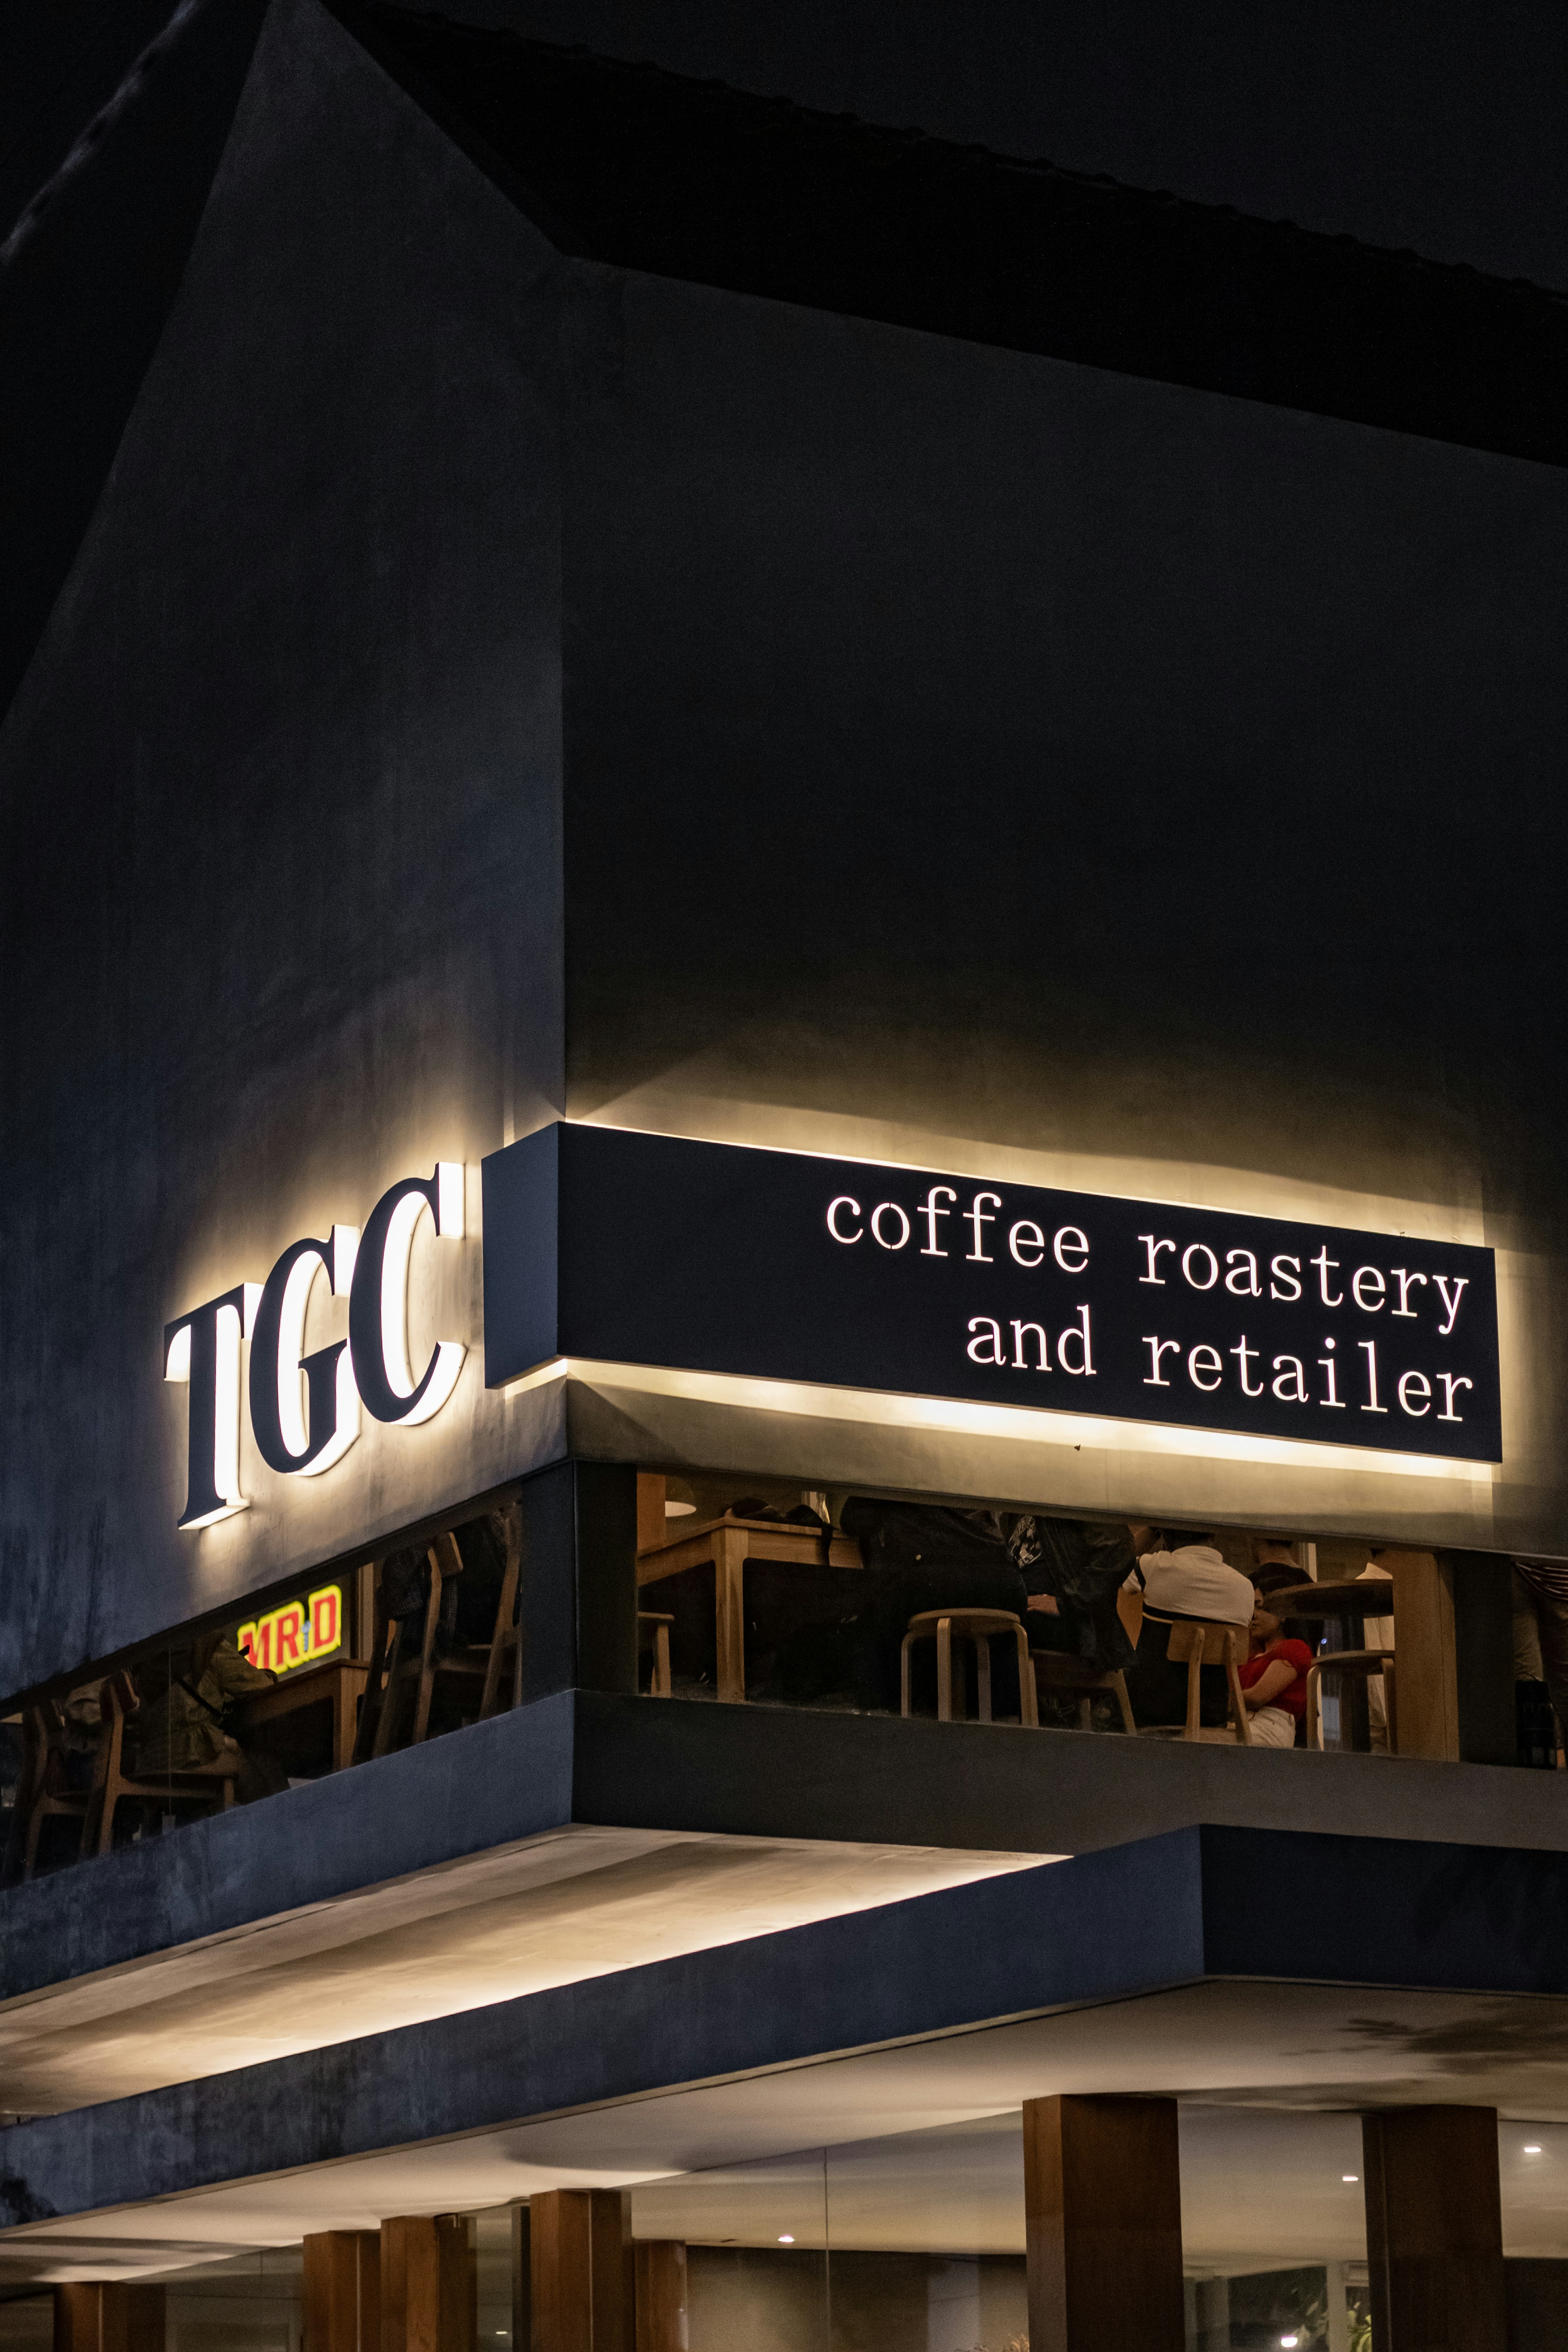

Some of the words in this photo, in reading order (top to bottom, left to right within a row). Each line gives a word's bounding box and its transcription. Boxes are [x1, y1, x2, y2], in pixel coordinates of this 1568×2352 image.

[826, 1186, 1090, 1273] coffee
[1138, 1235, 1470, 1335] roastery
[164, 1161, 467, 1530] TGC
[967, 1304, 1097, 1376] and
[1142, 1334, 1473, 1422] retailer
